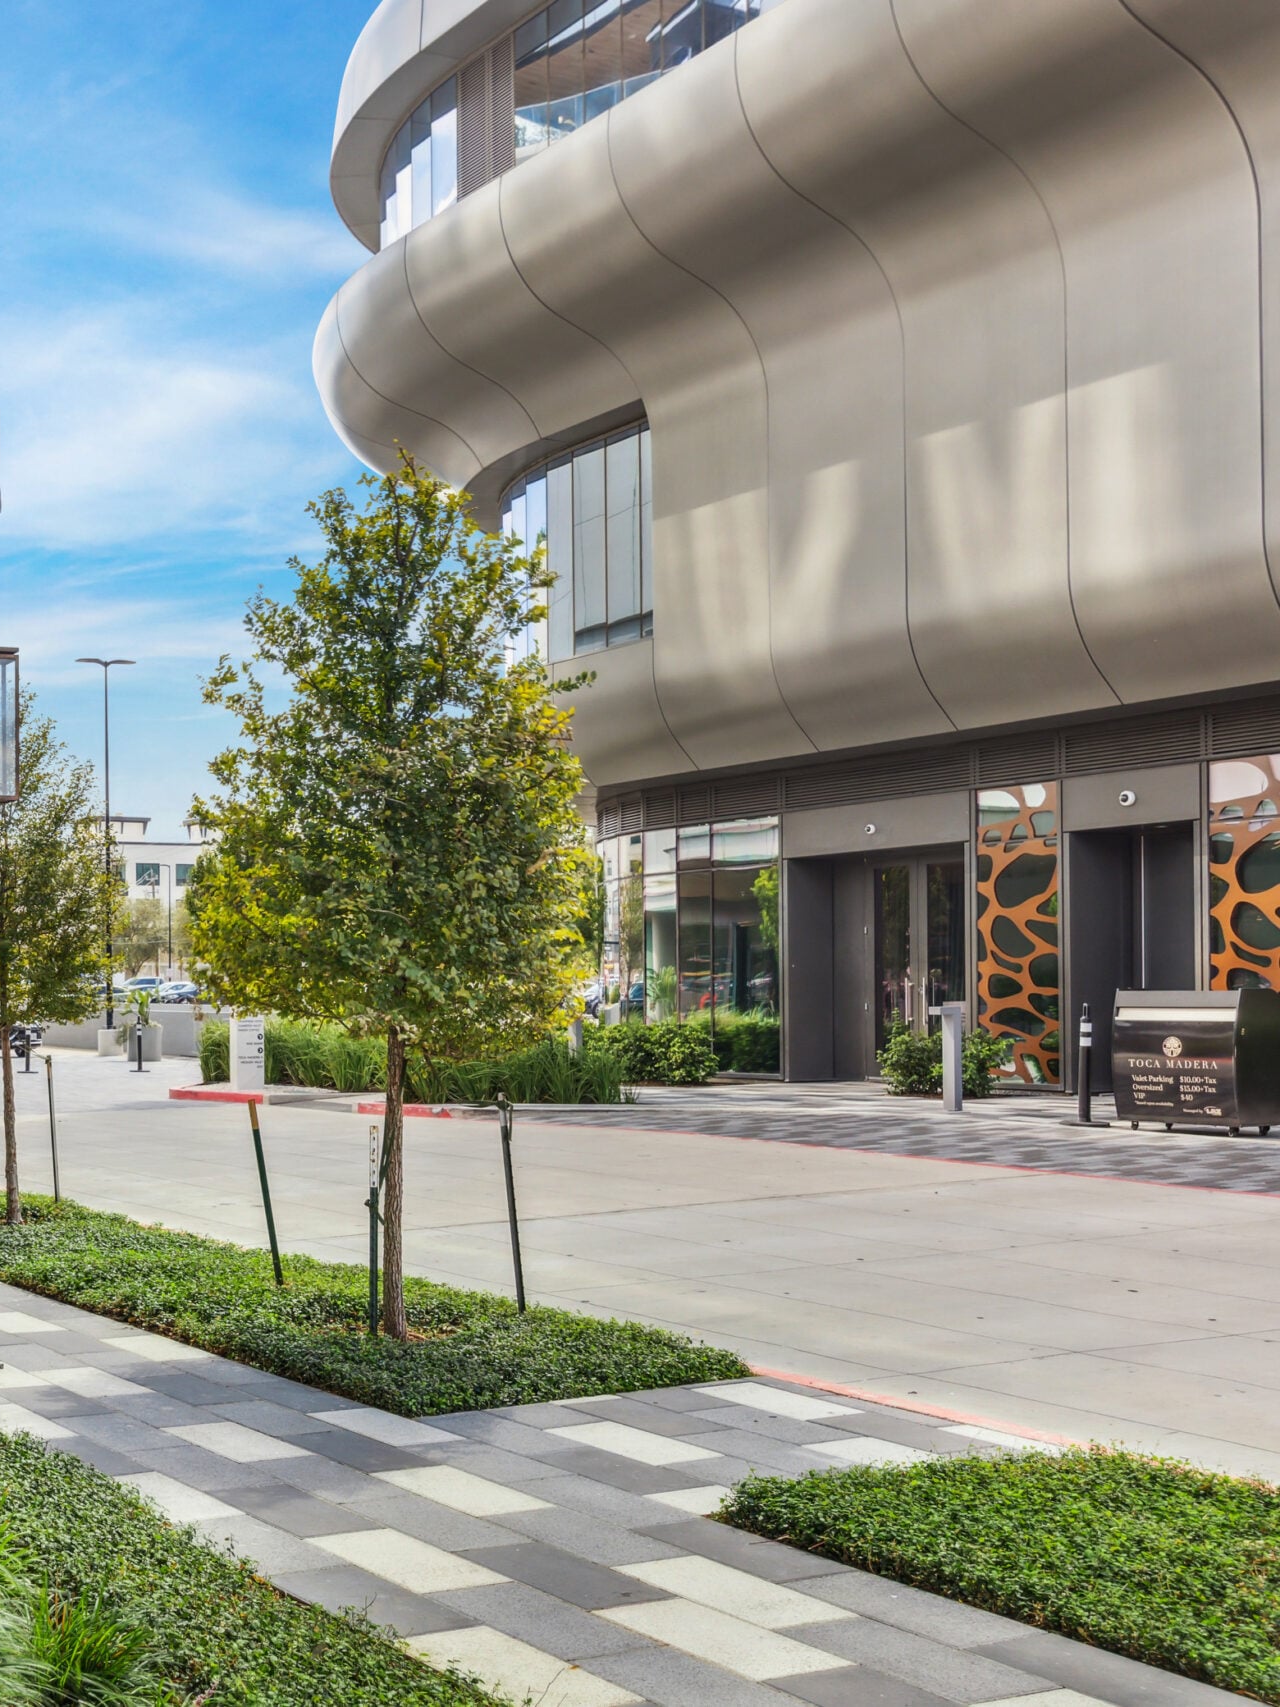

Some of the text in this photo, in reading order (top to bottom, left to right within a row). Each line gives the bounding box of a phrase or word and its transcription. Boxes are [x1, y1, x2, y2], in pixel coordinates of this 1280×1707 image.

[1128, 1058, 1218, 1070] TOCA MADERA
[1131, 1074, 1174, 1084] Valet Parking
[1132, 1083, 1163, 1091] Oversized
[1180, 1093, 1194, 1101] $40
